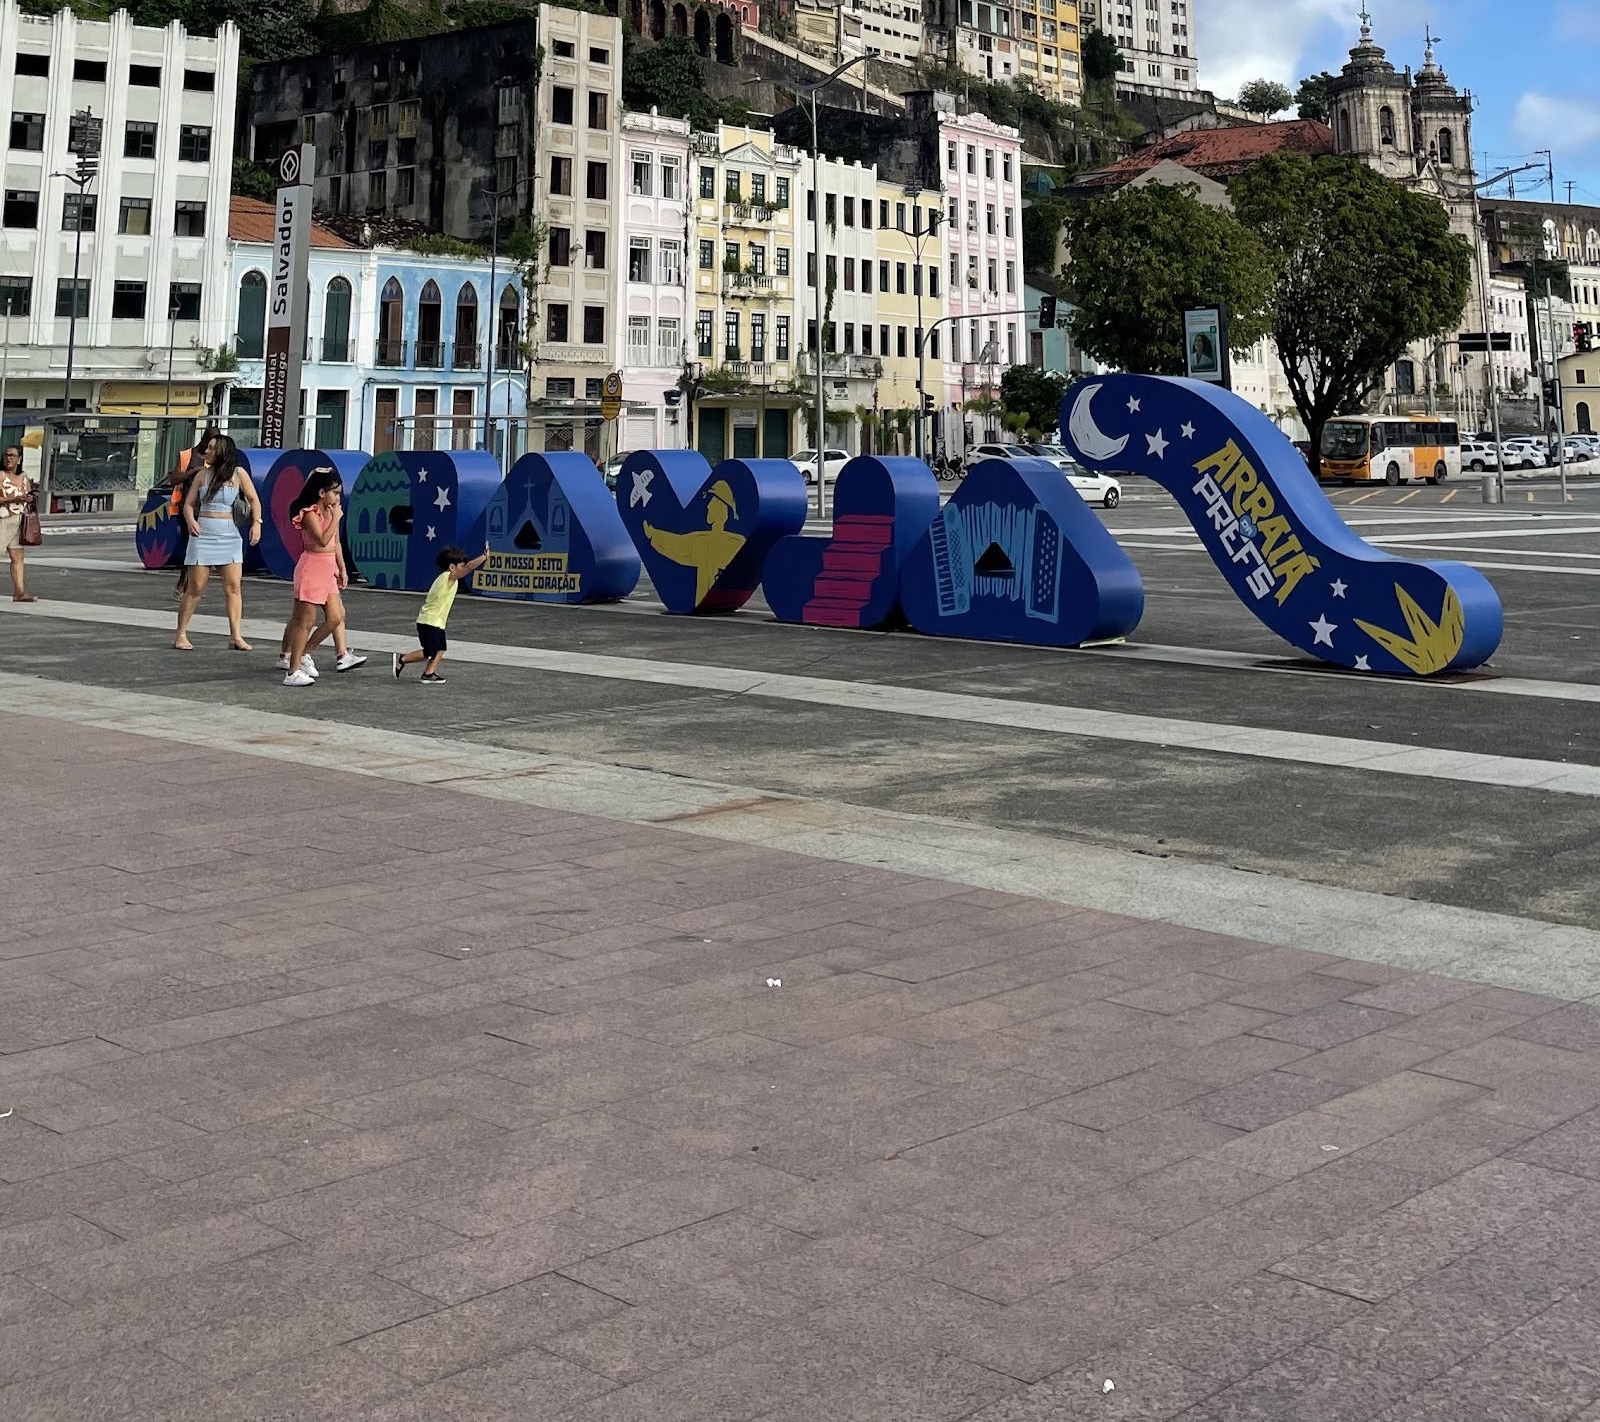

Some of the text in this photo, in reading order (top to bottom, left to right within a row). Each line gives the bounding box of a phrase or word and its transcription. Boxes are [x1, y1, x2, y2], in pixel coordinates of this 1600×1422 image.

[273, 197, 293, 315] Salvador
[263, 352, 277, 449] ônio Mundial
[273, 351, 288, 449] orld Heritage
[489, 555, 563, 571] DO NOSSO JEITO
[1192, 437, 1321, 608] ARRAIÁ
[1192, 473, 1276, 600] PREFS
[477, 573, 576, 592] E DO NOSSO CORAÇÃO
